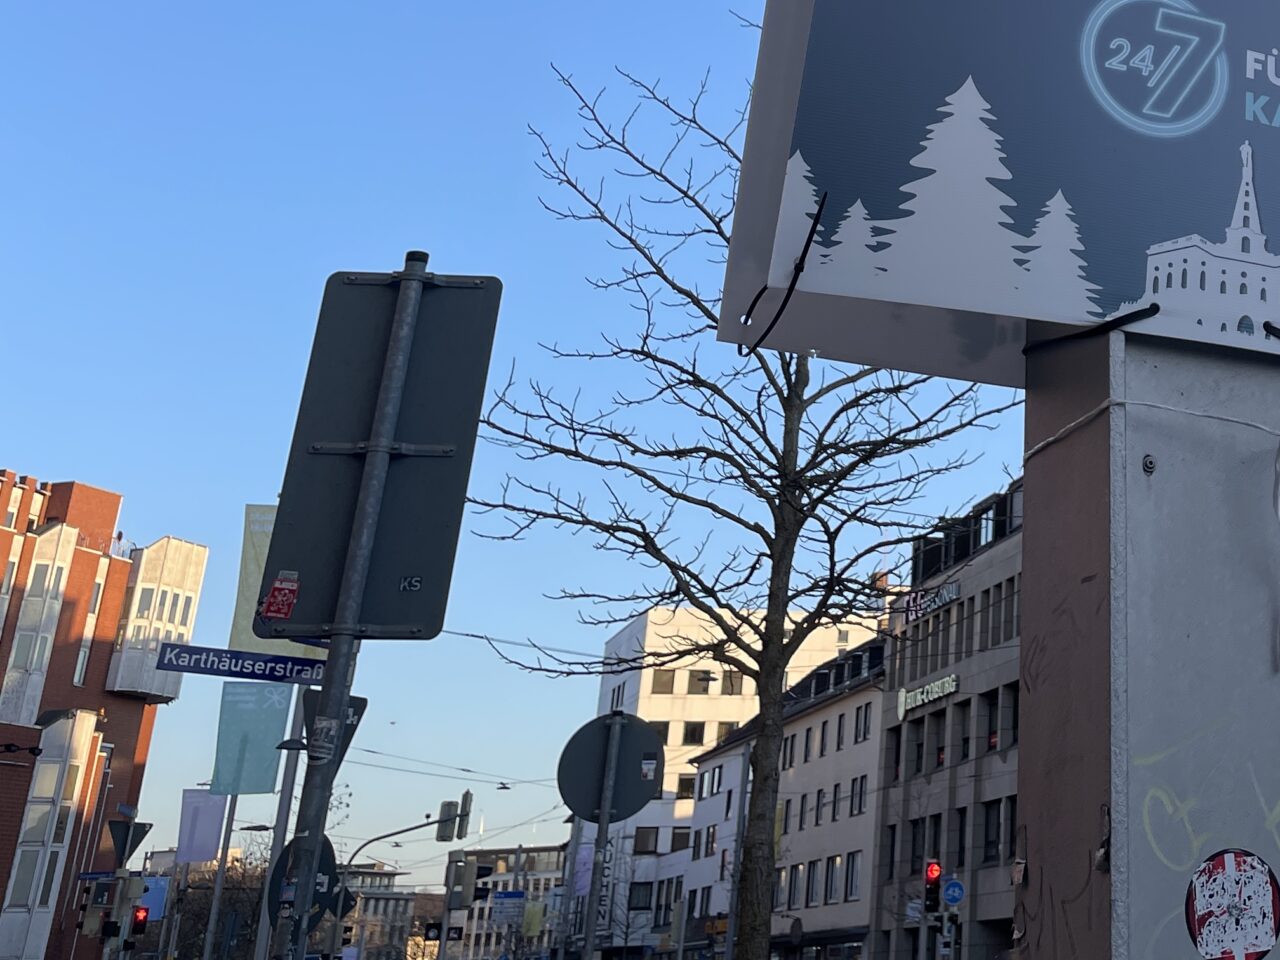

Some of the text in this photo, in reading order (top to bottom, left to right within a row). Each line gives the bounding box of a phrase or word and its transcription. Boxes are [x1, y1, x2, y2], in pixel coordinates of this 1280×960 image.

[1105, 7, 1226, 118] 24/7
[400, 577, 421, 591] KS
[163, 647, 325, 680] Karthäuserstraß
[906, 674, 958, 710] HUK-COBURG
